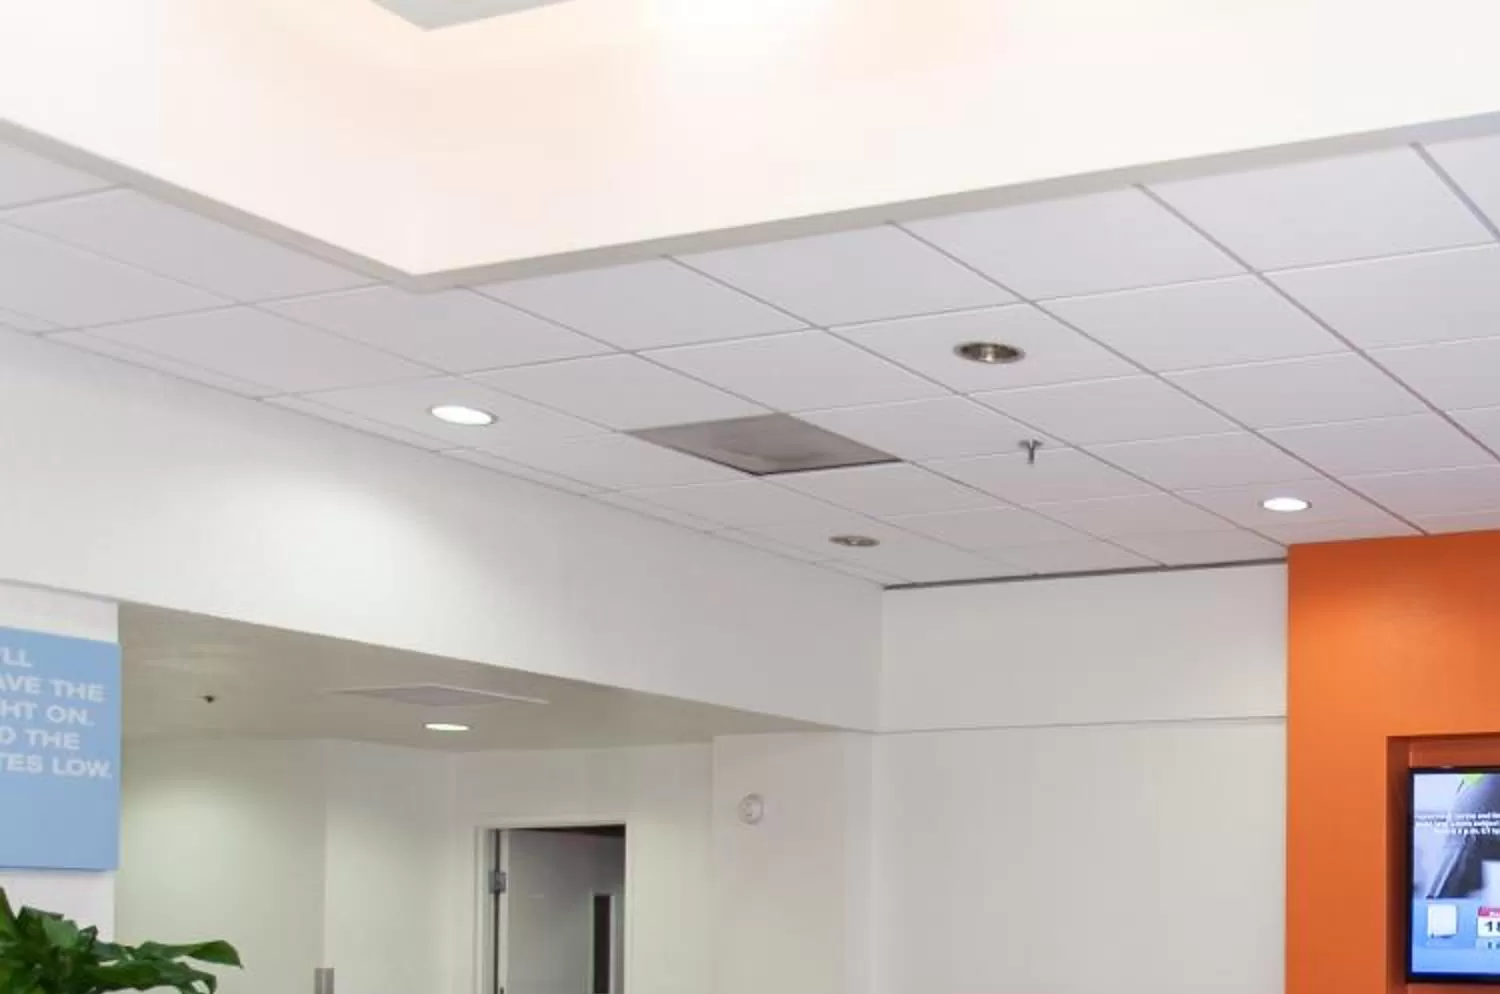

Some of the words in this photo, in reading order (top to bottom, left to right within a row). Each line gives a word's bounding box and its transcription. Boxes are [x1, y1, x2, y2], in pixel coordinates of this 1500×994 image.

[50, 678, 105, 703] THE
[45, 704, 95, 727] ON.
[24, 728, 80, 749] THE
[52, 755, 112, 779] LOW.
